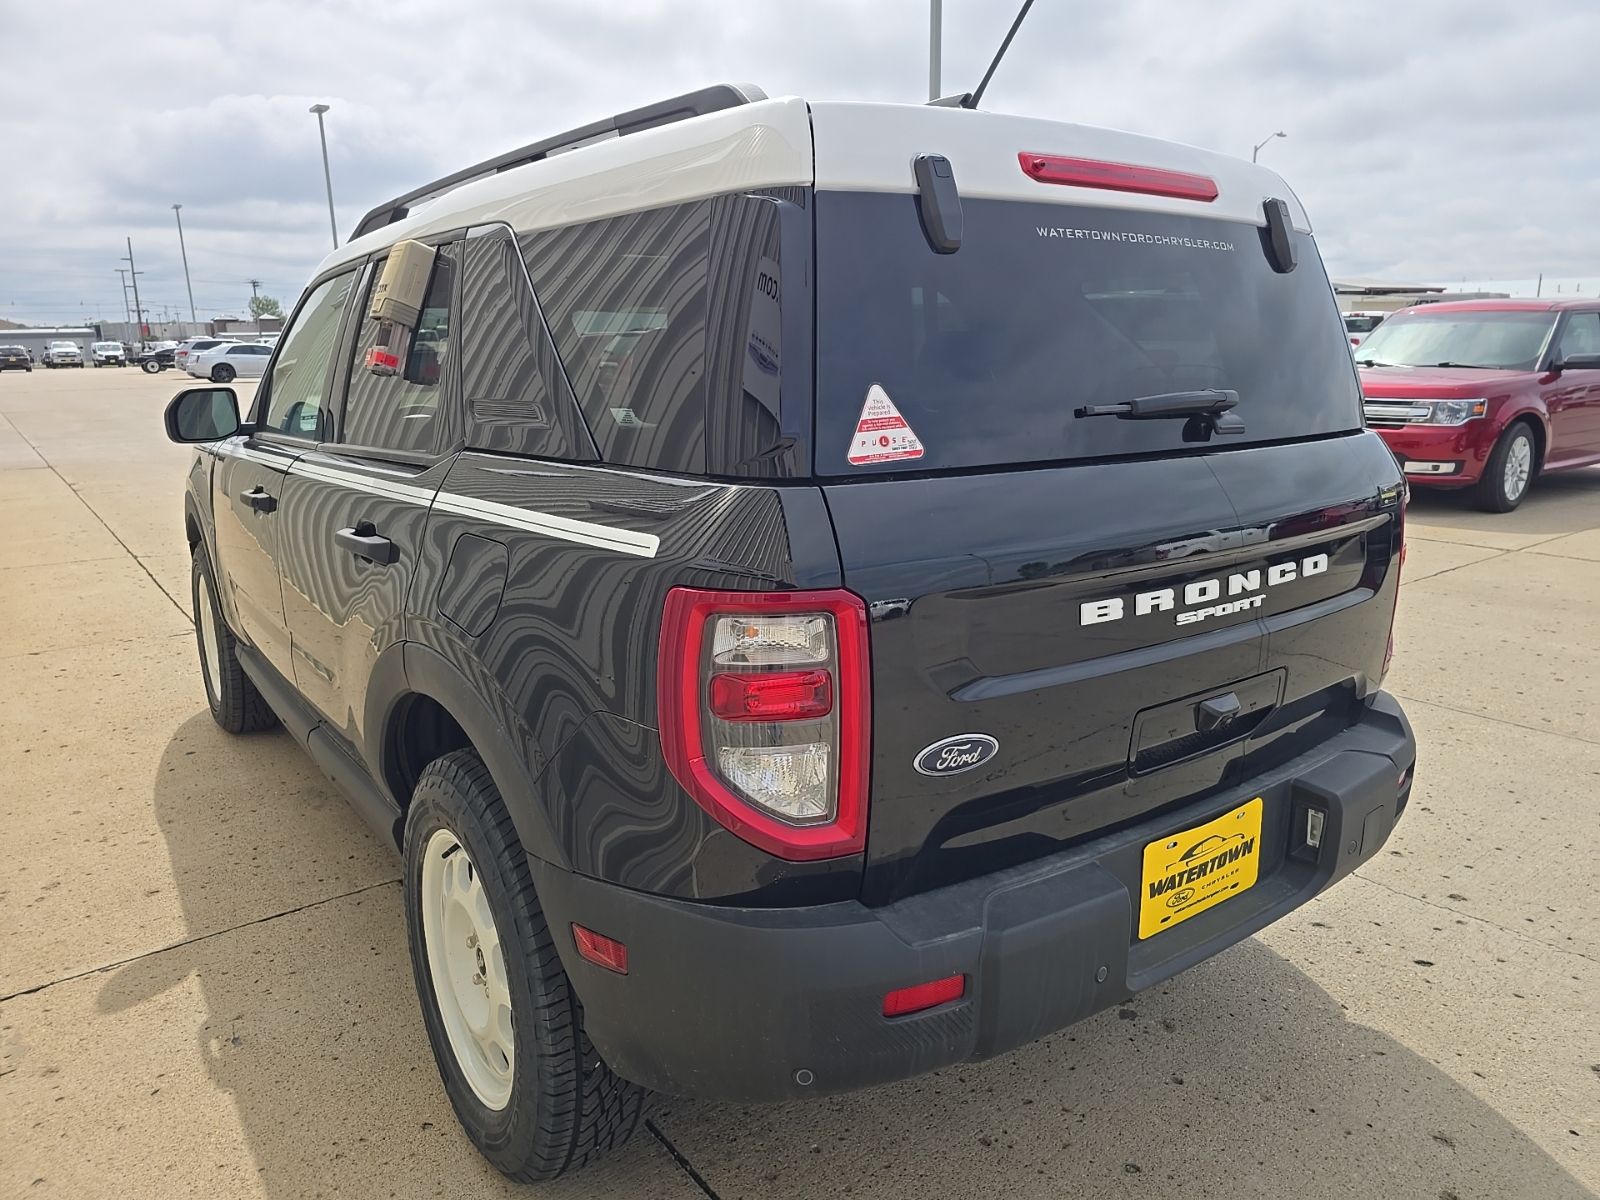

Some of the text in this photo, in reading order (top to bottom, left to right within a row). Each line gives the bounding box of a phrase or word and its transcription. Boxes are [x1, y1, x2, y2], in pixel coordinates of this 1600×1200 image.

[1080, 553, 1329, 626] BRONCO
[1175, 594, 1267, 626] SPORT
[936, 743, 983, 770] Ford
[1149, 838, 1254, 900] WATERTOWN
[1201, 868, 1240, 890] CHRYSLER
